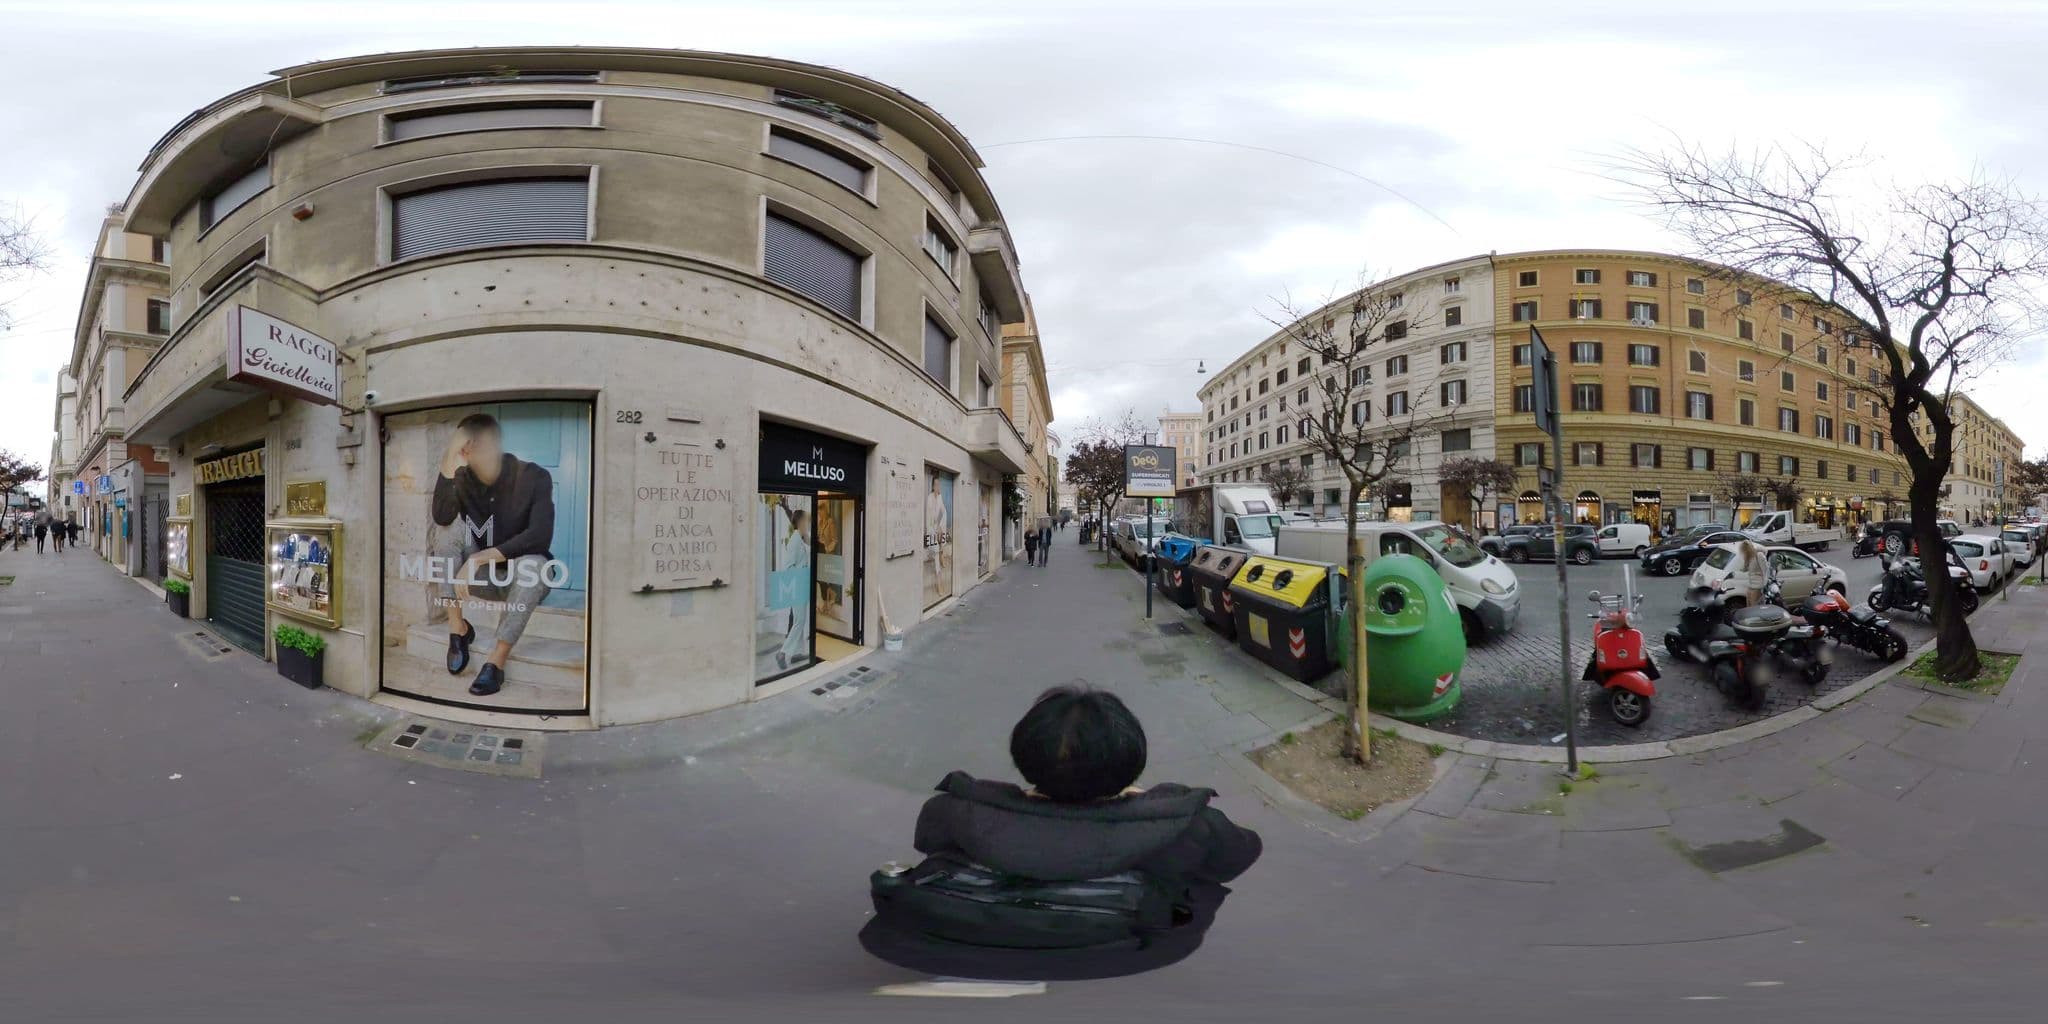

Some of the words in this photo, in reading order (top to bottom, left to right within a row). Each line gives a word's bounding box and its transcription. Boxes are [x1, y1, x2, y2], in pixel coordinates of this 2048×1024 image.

[269, 324, 332, 364] RAGGI
[245, 347, 333, 392] Gioielleria
[616, 410, 643, 424] 282
[658, 450, 714, 468] TUTTE
[812, 445, 823, 461] M
[201, 449, 263, 481] RAGGI
[784, 459, 845, 482] MELLUSO
[676, 470, 696, 484] LE
[637, 486, 732, 503] OPERAZIONI
[678, 506, 694, 520] DI
[465, 514, 494, 547] M
[655, 524, 714, 538] BANCA
[651, 541, 718, 556] CAMBIO
[924, 532, 952, 550] ELLUSO
[399, 553, 569, 588] MELLUSO
[655, 559, 712, 574] BORSA
[434, 597, 464, 609] NEXT
[468, 600, 527, 613] OPENING
